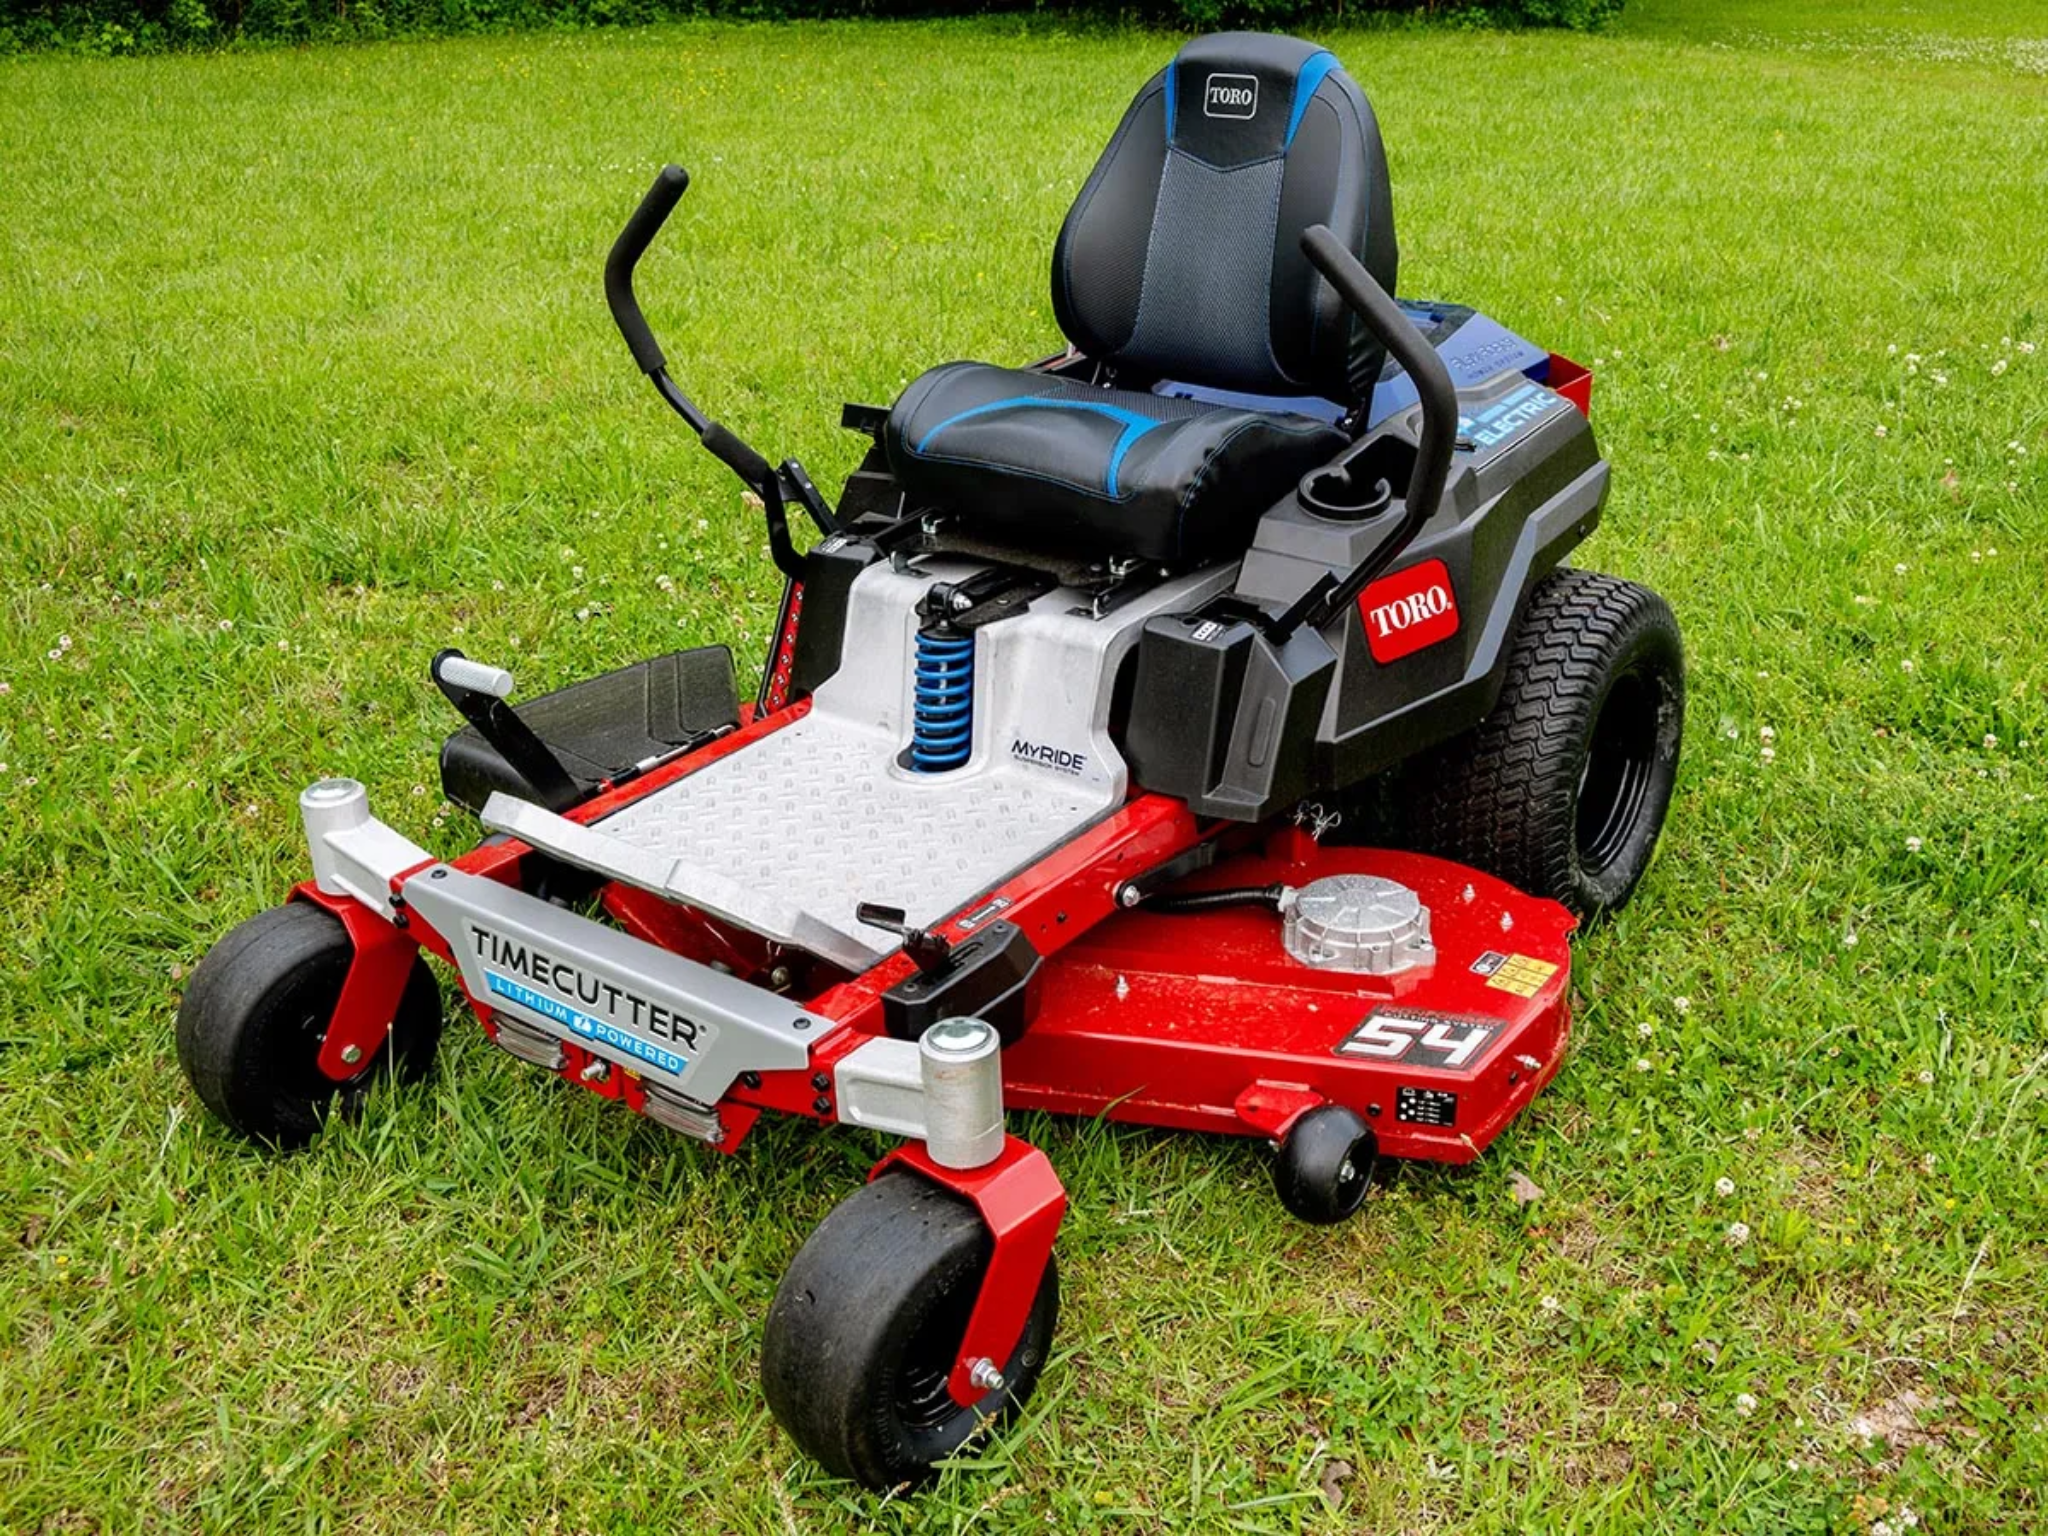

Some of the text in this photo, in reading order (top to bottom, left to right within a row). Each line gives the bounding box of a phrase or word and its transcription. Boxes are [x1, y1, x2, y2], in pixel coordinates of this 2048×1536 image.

[1209, 86, 1252, 106] TORO
[1473, 391, 1558, 446] ELECTRIC
[1369, 584, 1450, 638] TORO
[495, 977, 680, 1071] LITHIUM POWERED
[1340, 1014, 1491, 1067] 54
